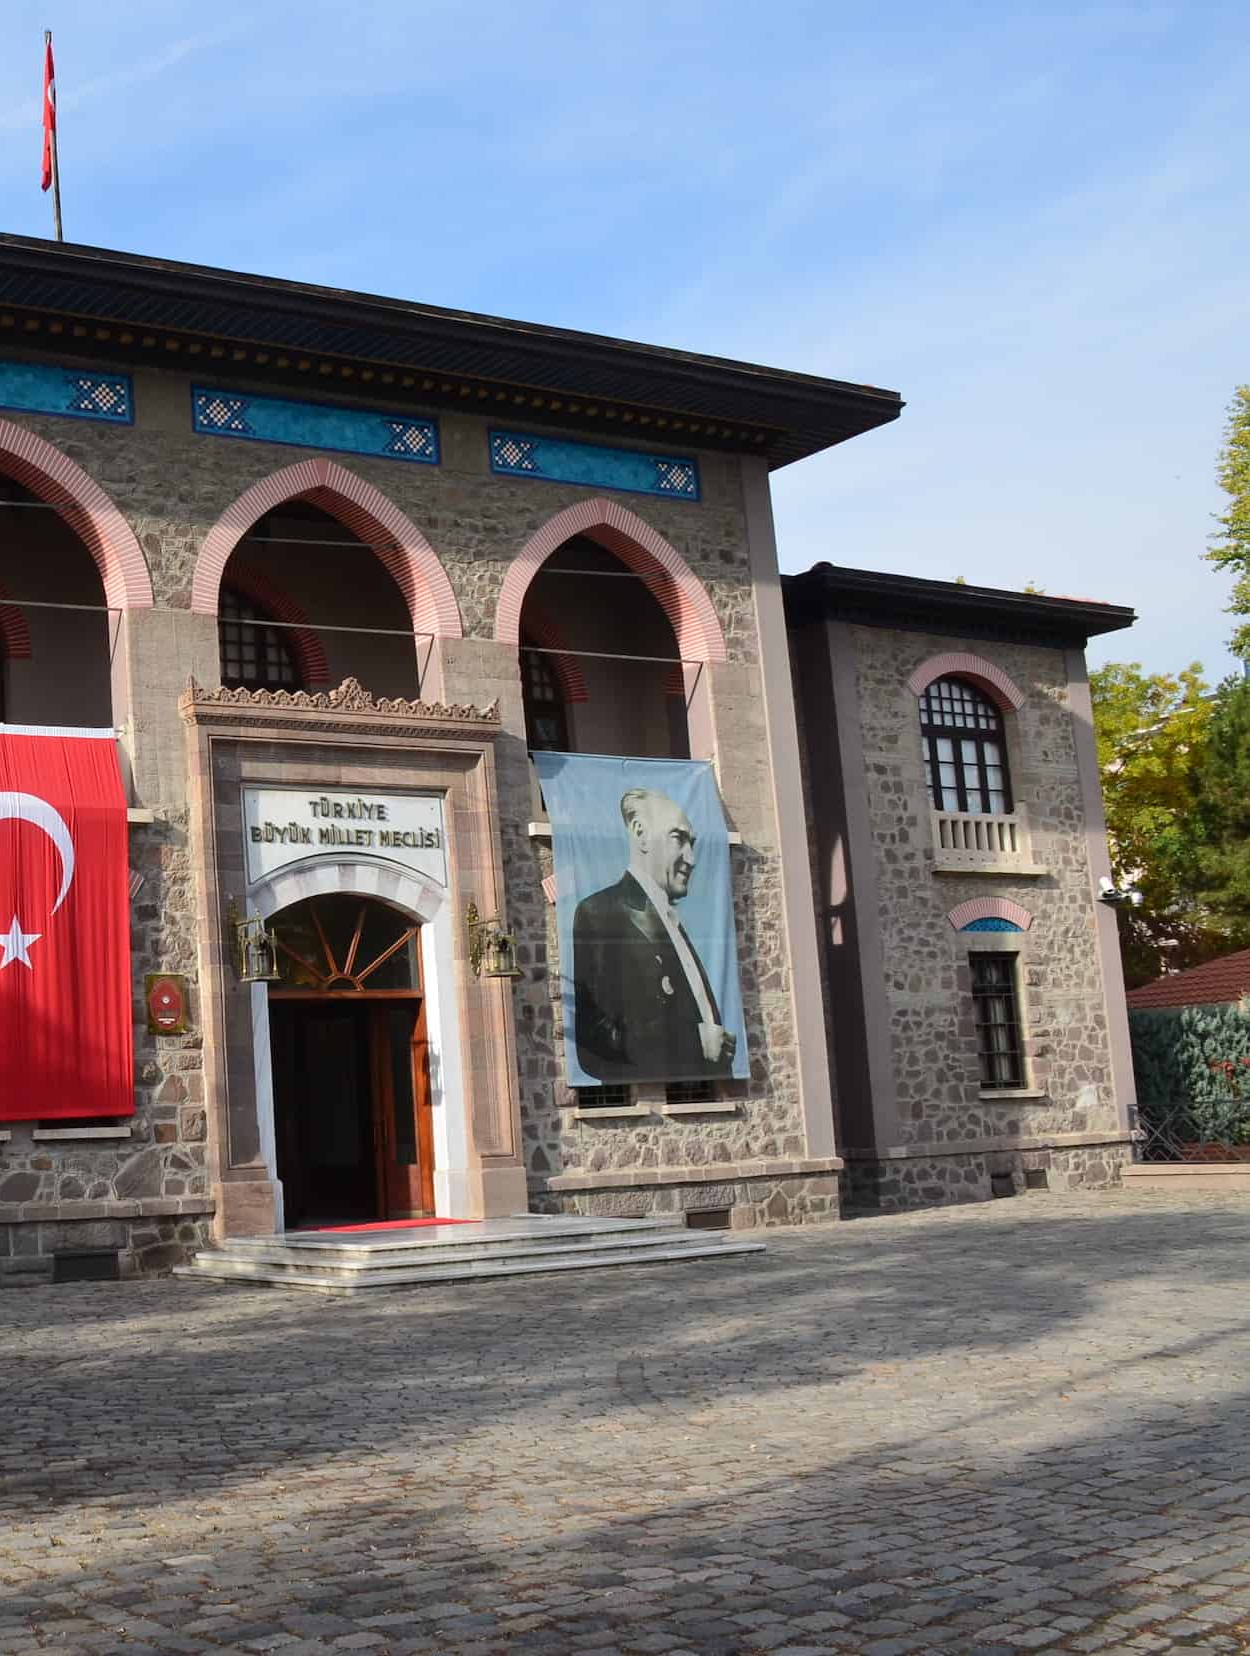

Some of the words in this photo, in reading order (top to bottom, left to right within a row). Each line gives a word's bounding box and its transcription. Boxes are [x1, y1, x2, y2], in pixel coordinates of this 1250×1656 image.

[309, 797, 387, 820] TÜRKİYE
[251, 822, 311, 843] BÜYÜK
[318, 824, 373, 847] MİLLET
[379, 827, 440, 849] MECLİSİ
